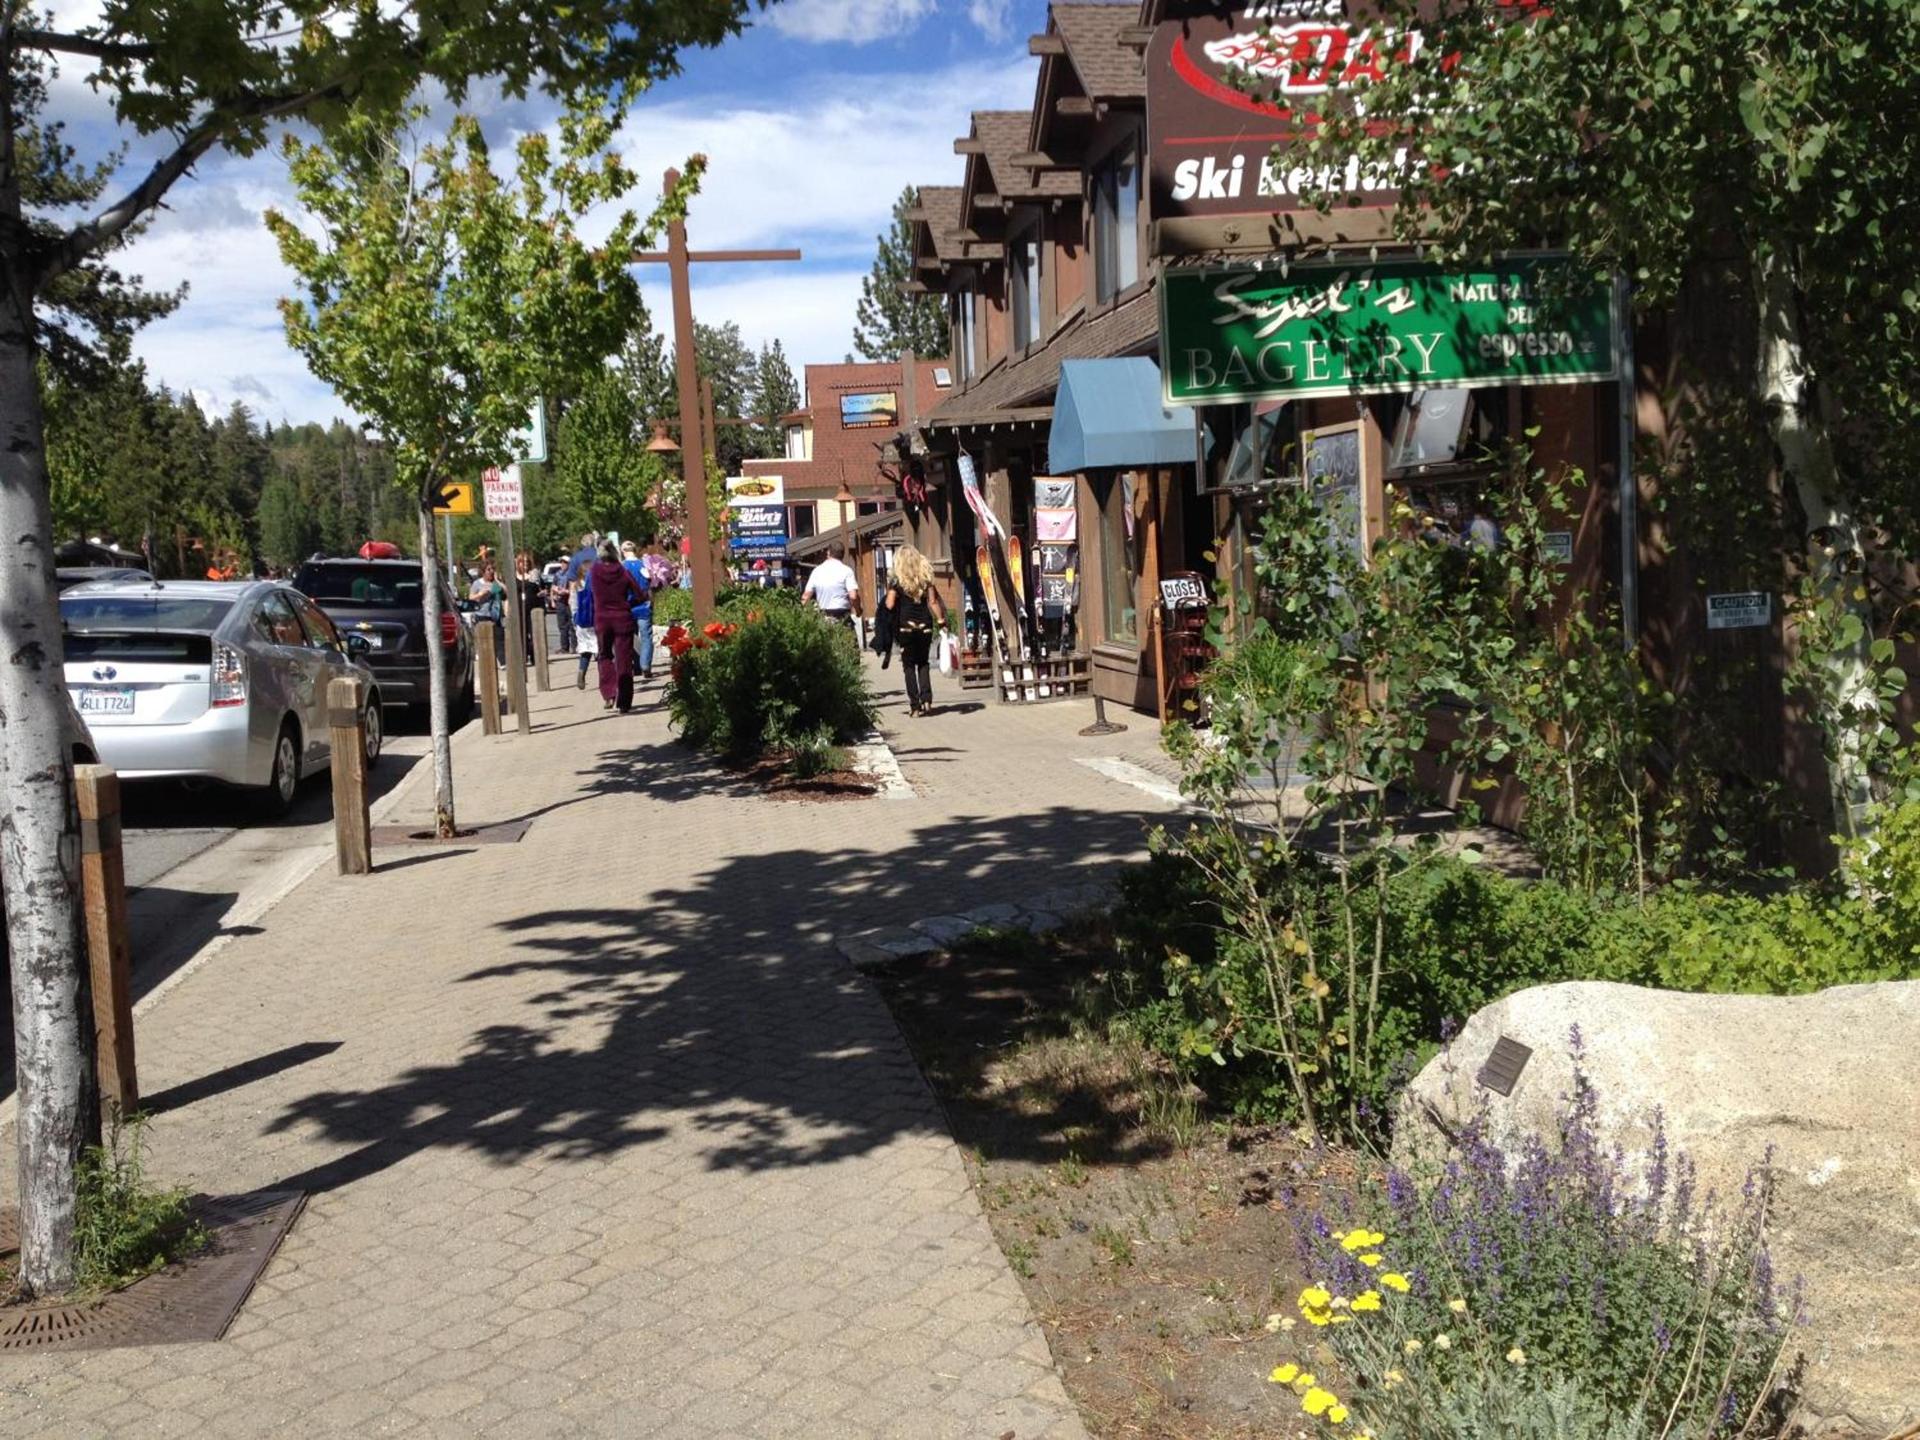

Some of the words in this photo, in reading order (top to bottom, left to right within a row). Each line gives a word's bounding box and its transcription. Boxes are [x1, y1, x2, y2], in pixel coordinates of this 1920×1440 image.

[1171, 155, 1245, 200] Ski
[1478, 330, 1573, 367] espresso
[1184, 332, 1446, 390] BAGELRY
[484, 466, 499, 480] NO
[485, 482, 519, 492] PARKING
[1714, 596, 1762, 609] CAUTION
[81, 697, 129, 710] 6LLT724
